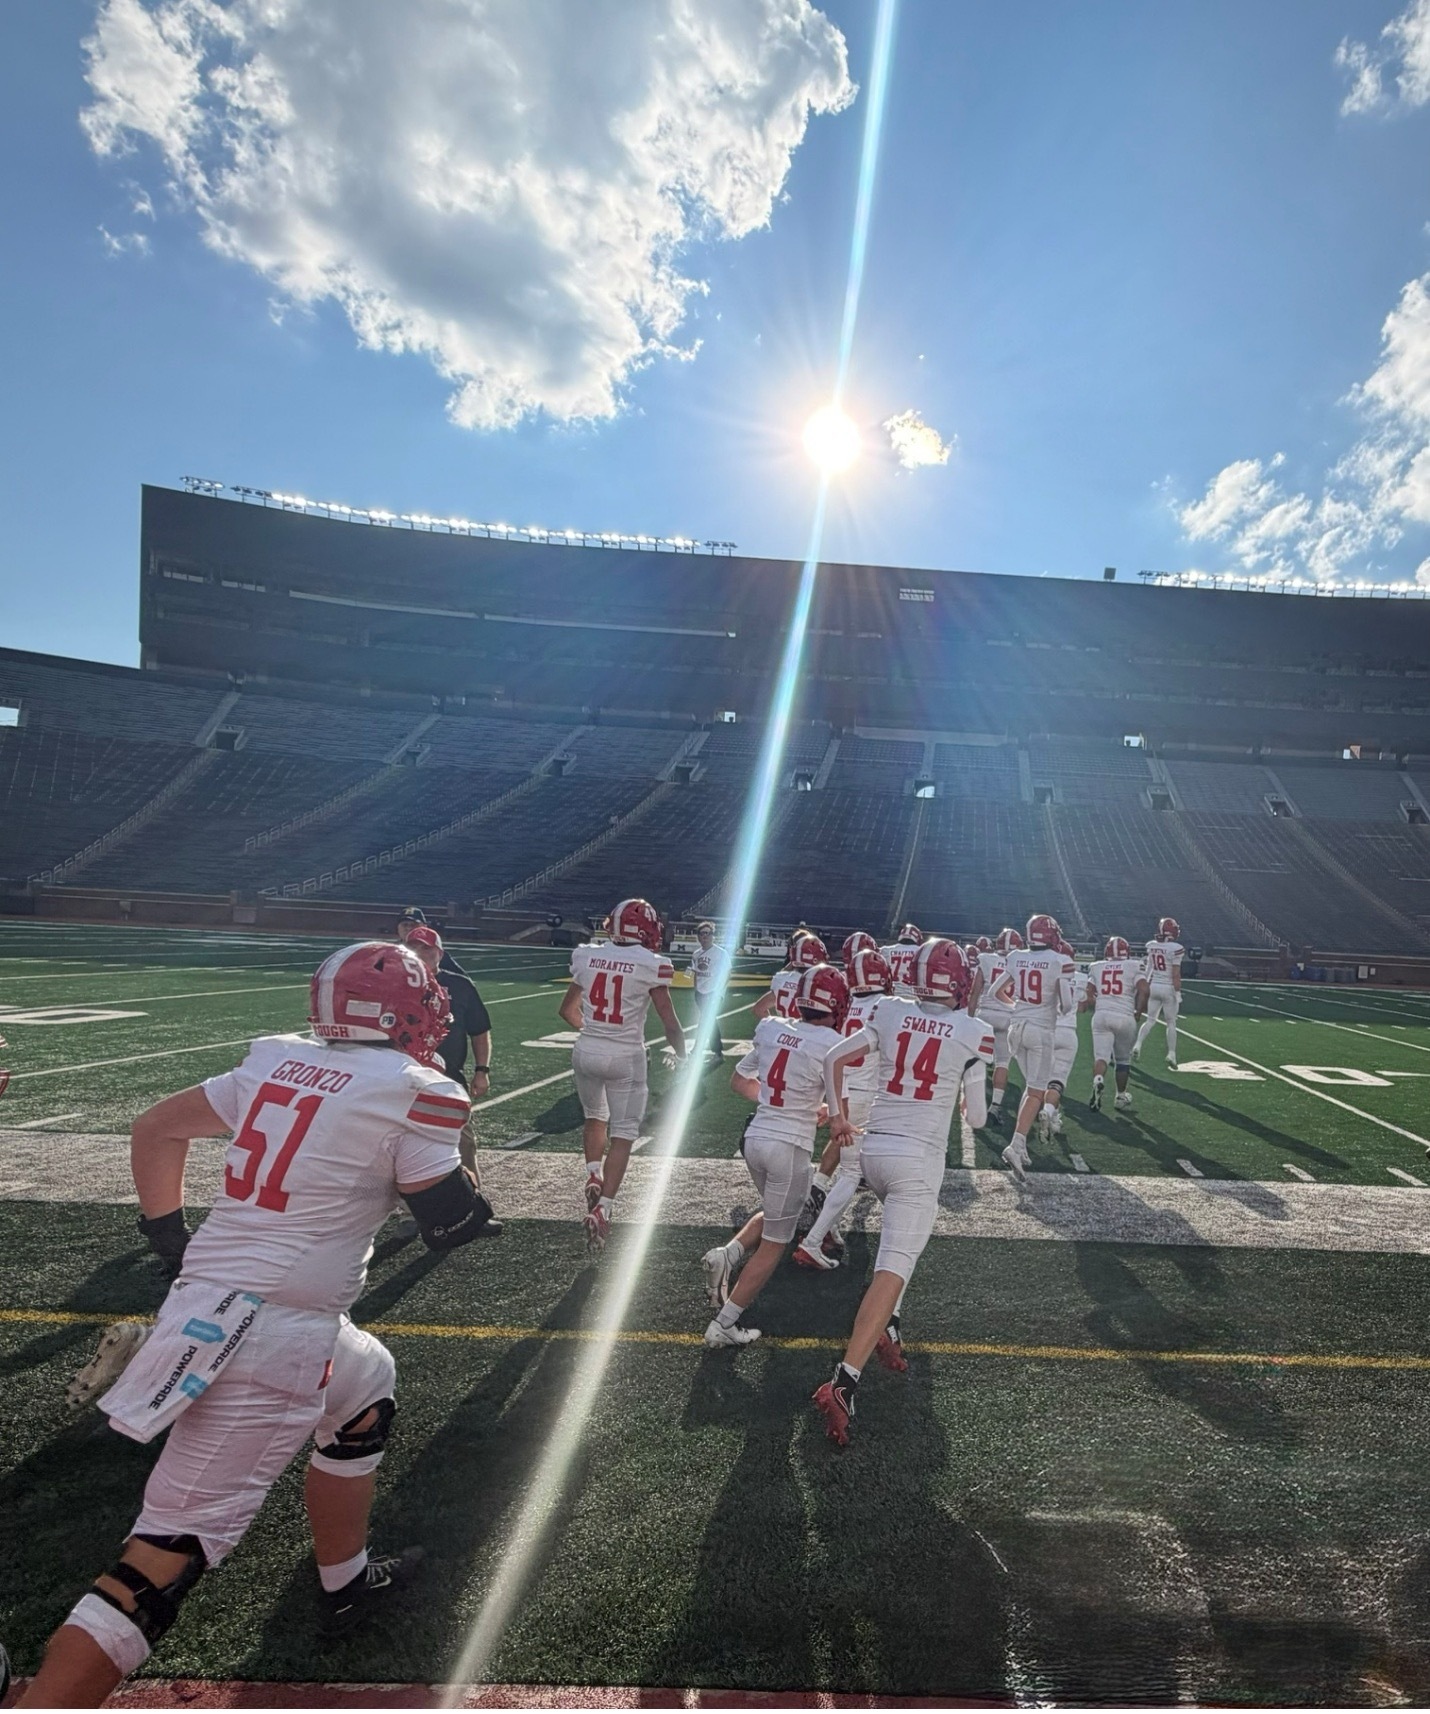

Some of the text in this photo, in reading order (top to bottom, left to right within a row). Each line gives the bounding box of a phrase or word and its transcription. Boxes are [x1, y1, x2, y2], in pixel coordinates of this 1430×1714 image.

[589, 958, 634, 973] MORANTES
[1152, 954, 1166, 971] 18
[589, 972, 623, 1025] 41
[1019, 969, 1042, 1005] 19
[1101, 970, 1123, 995] 55
[777, 1033, 802, 1048] COOK
[902, 1016, 954, 1037] SWARTZ
[271, 1060, 353, 1094] GRONZO
[767, 1048, 790, 1107] 4
[886, 1031, 942, 1100] 14
[224, 1081, 325, 1213] 51
[208, 1309, 256, 1372] POWERADE
[148, 1345, 198, 1410] POWERADE
